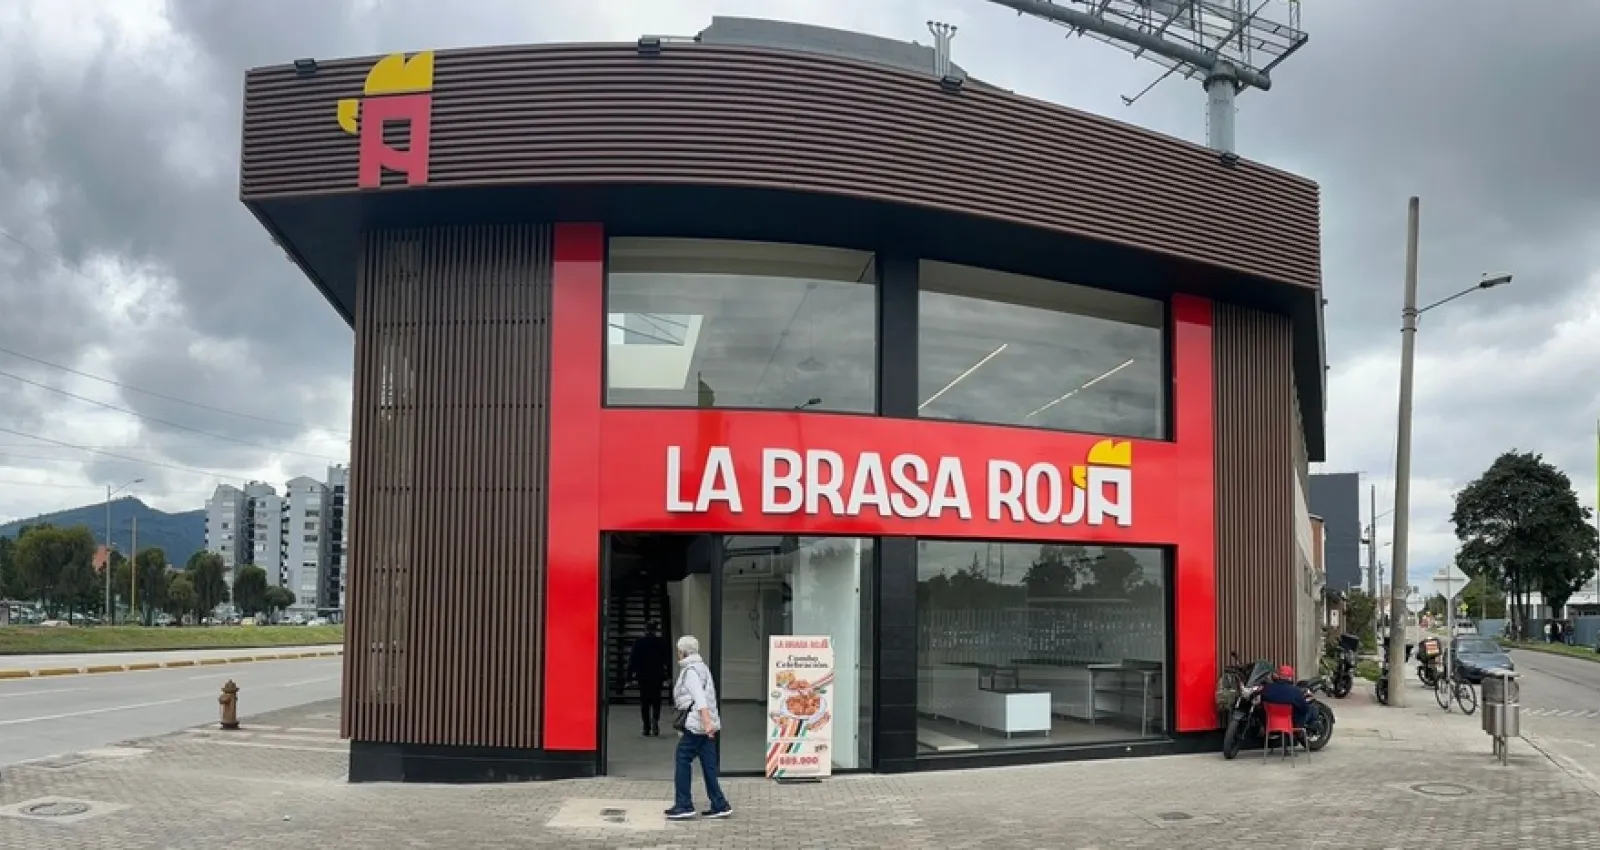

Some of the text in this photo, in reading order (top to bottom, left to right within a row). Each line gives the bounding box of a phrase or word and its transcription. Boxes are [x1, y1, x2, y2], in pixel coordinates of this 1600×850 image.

[666, 445, 1132, 527] LA BRASA ROJA
[774, 640, 784, 649] LA
[785, 640, 808, 649] BRASA
